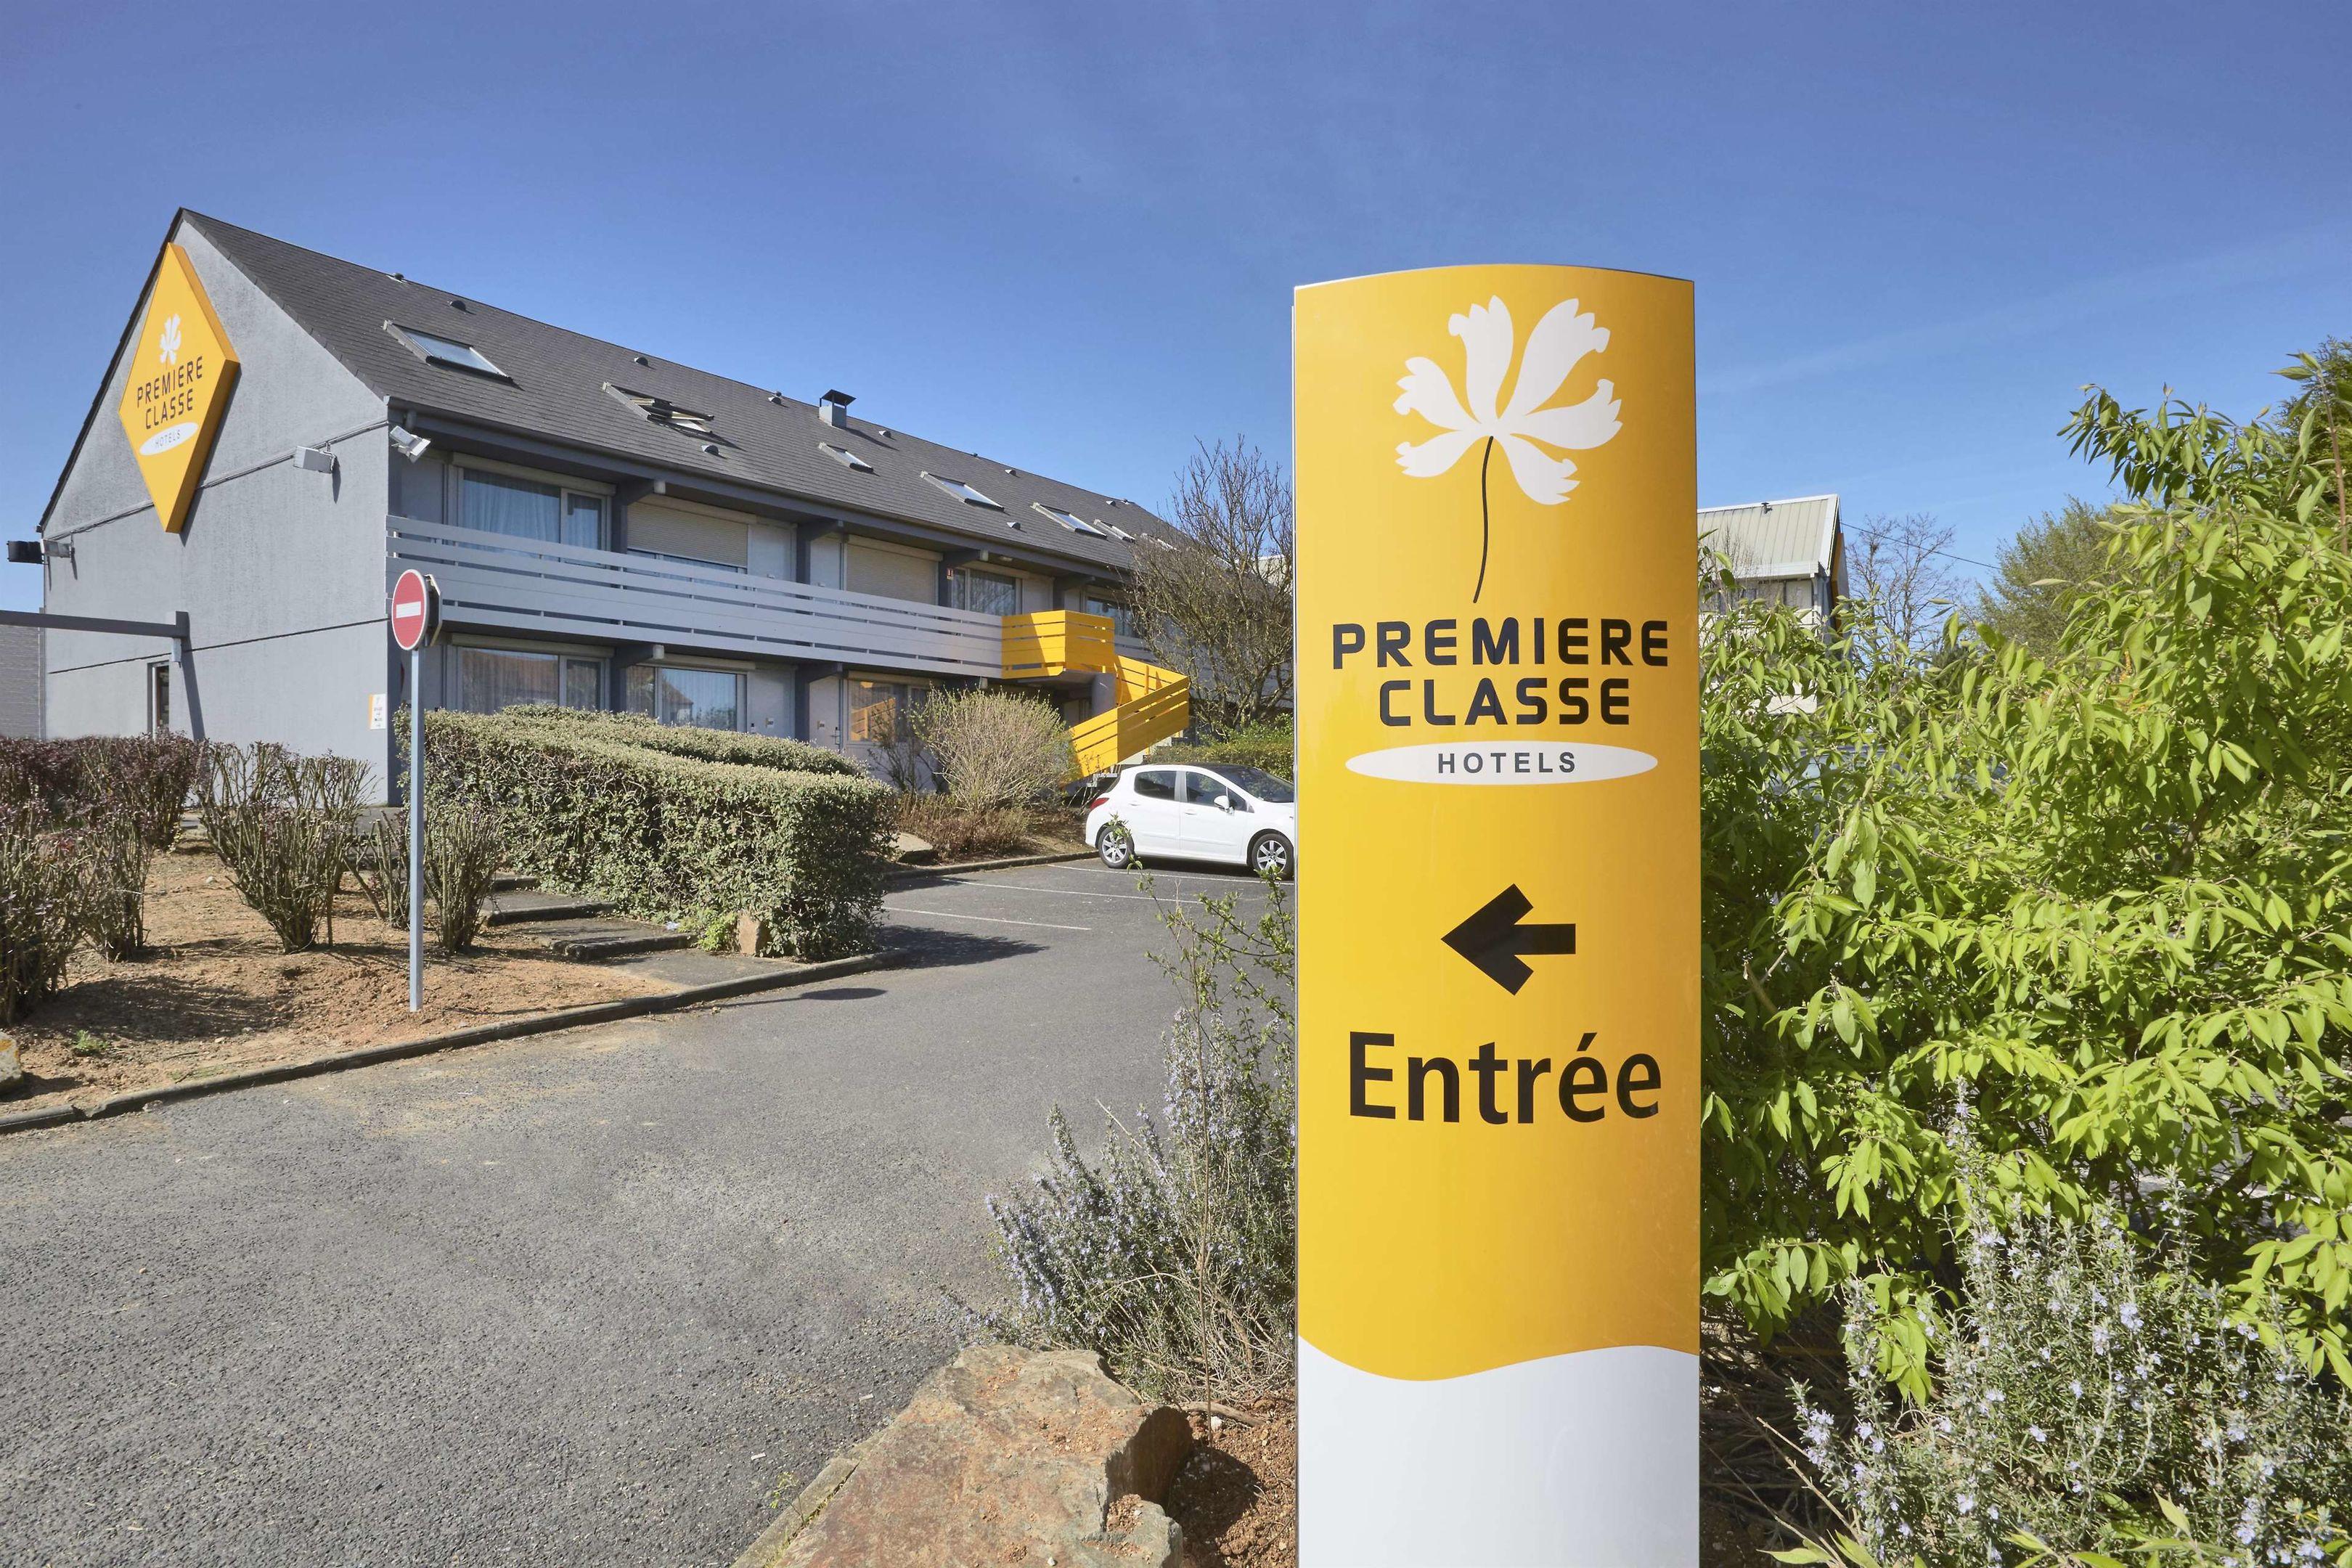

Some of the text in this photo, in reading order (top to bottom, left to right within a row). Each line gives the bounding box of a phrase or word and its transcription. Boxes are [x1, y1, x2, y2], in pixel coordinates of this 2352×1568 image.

[136, 356, 203, 408] PREMIERE
[145, 388, 193, 430] CLASSE
[1333, 617, 1668, 669] PREMIERE
[1380, 678, 1630, 726] CLASSE
[1438, 751, 1575, 774] HOTELS
[1349, 1032, 1662, 1125] Entrée
